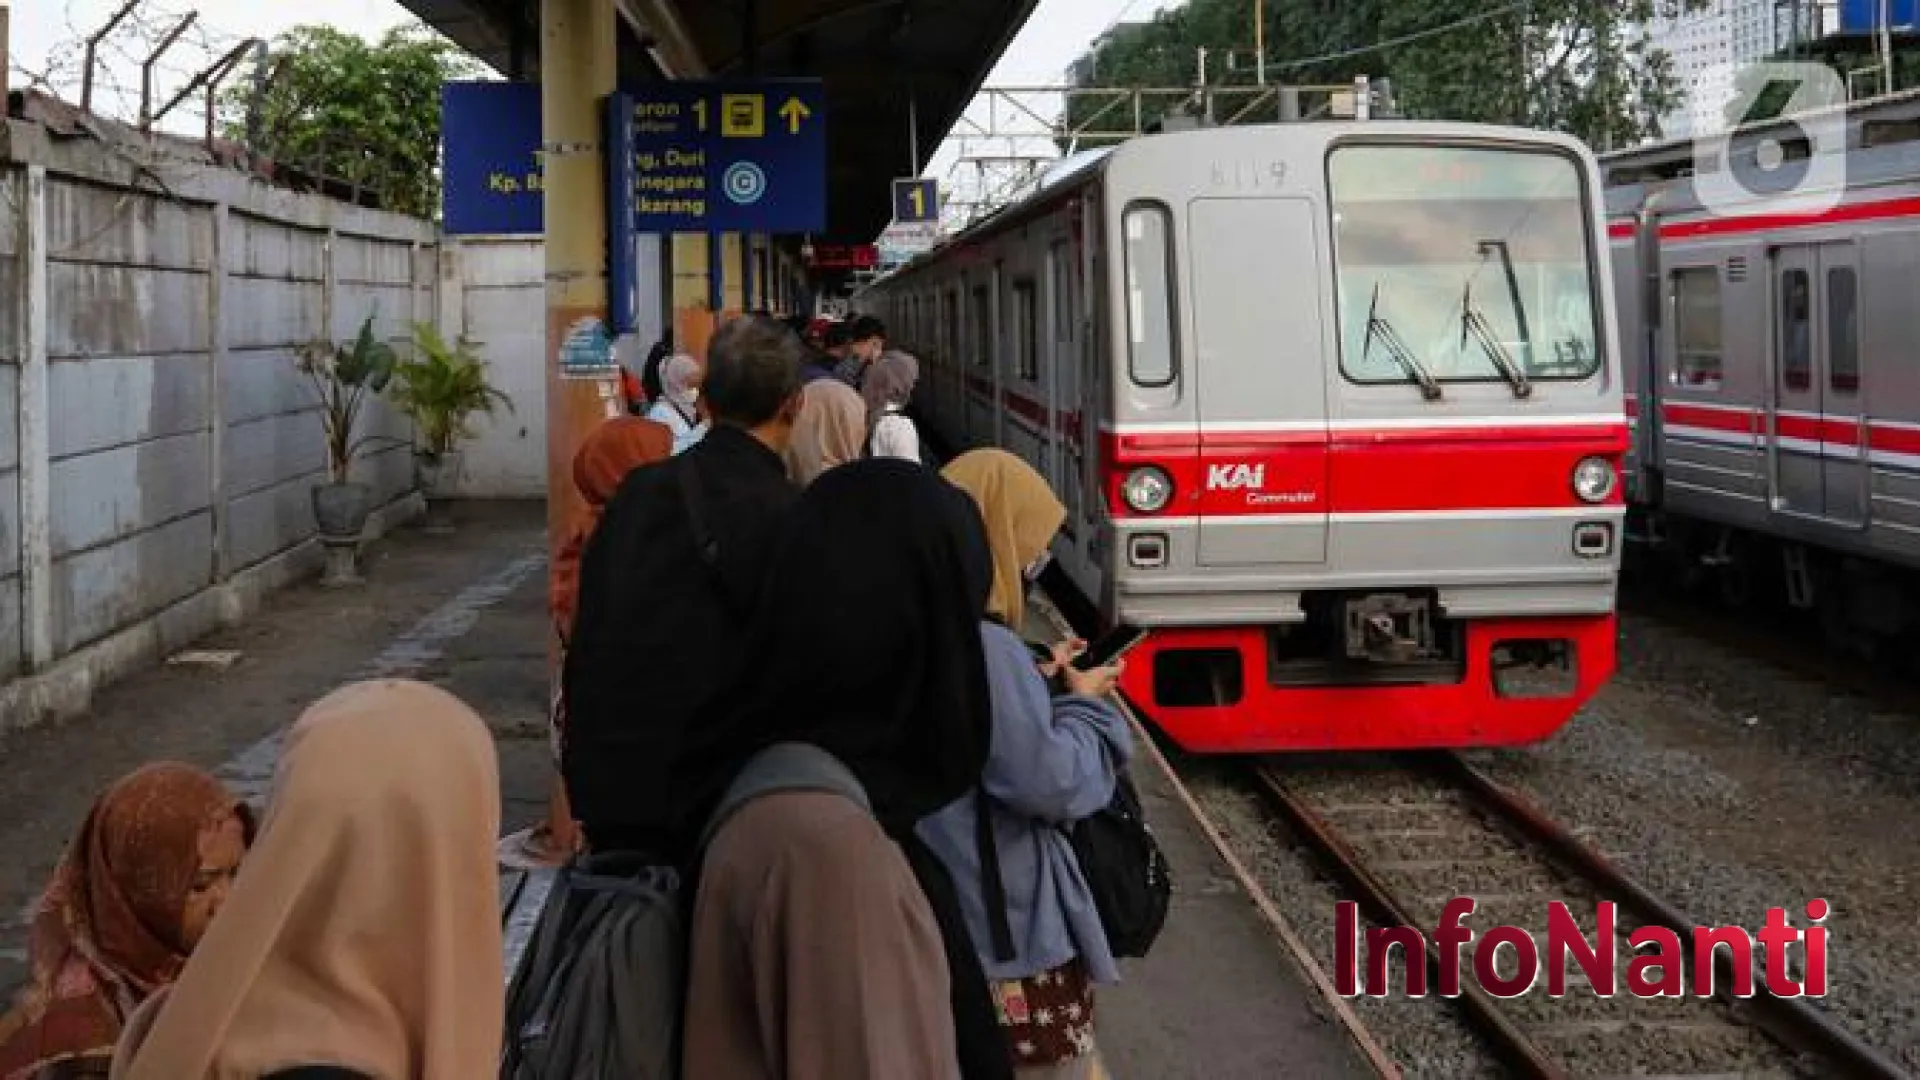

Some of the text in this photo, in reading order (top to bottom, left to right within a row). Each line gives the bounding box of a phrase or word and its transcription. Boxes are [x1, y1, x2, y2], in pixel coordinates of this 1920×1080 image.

[690, 99, 706, 131] 1
[490, 173, 522, 194] Kp.
[908, 186, 925, 218] 1
